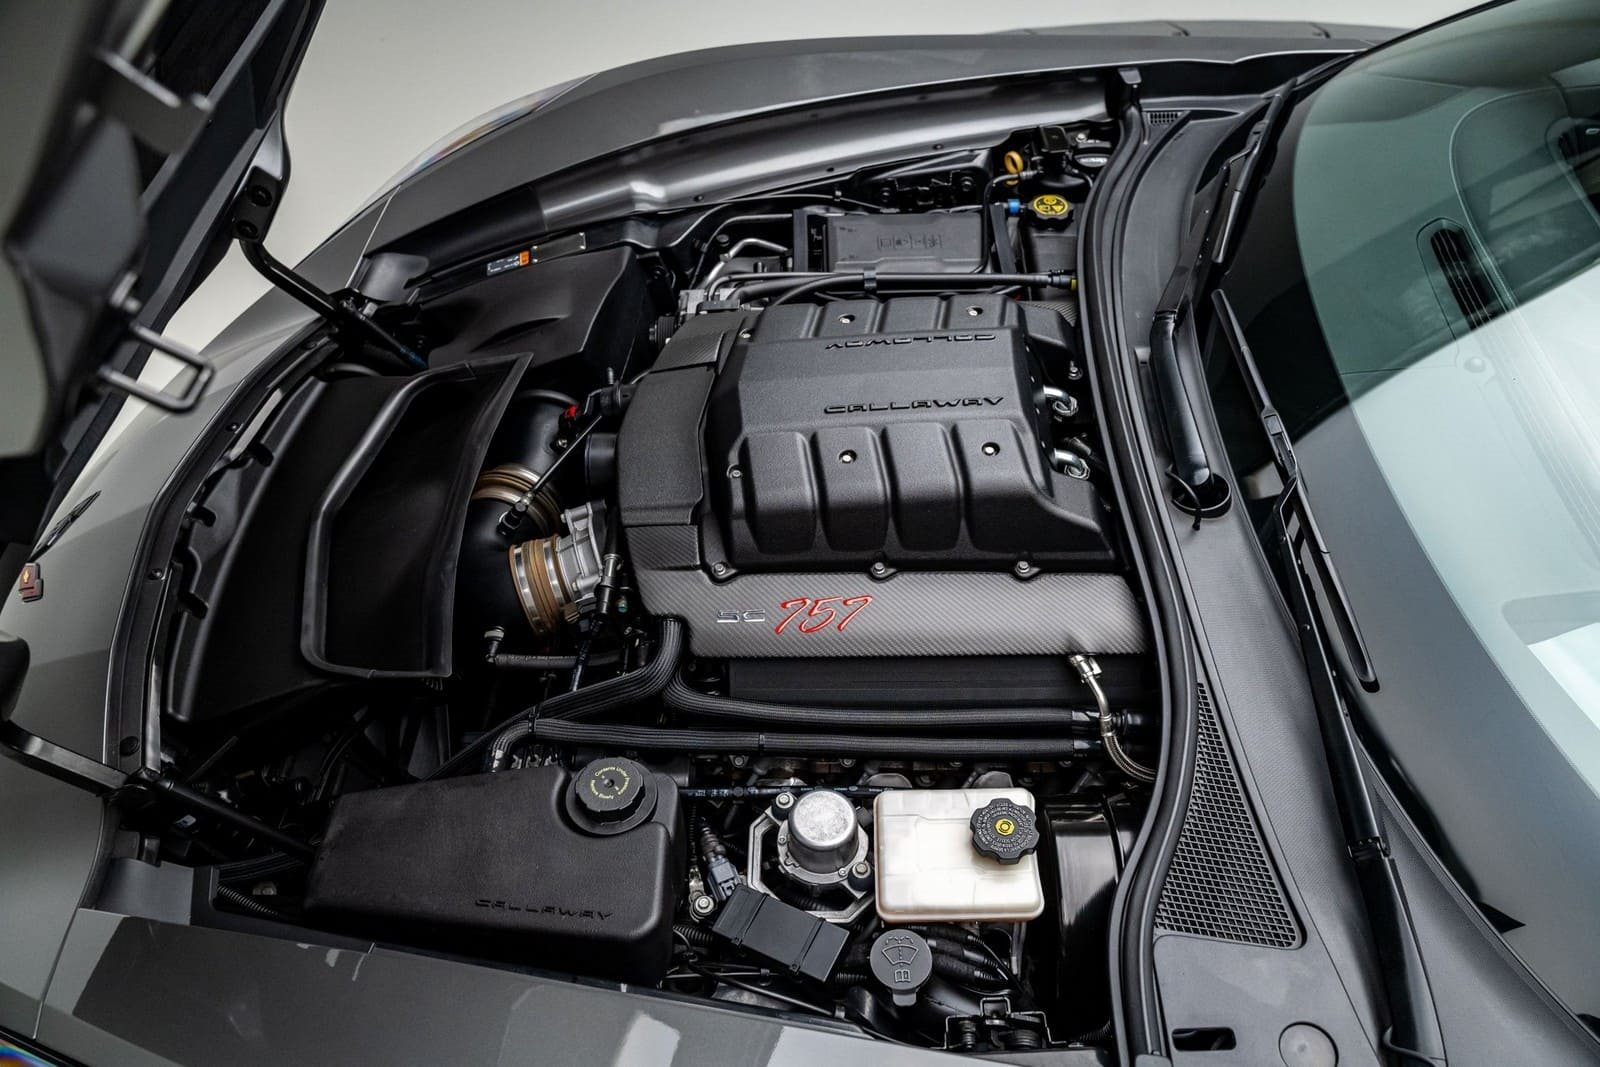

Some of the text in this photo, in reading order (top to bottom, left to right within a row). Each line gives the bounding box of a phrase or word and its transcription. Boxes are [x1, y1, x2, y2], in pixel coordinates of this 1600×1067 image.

[824, 397, 1004, 414] CALLAWAY
[716, 594, 873, 635] SC 757
[475, 899, 614, 920] CALLAWAY
